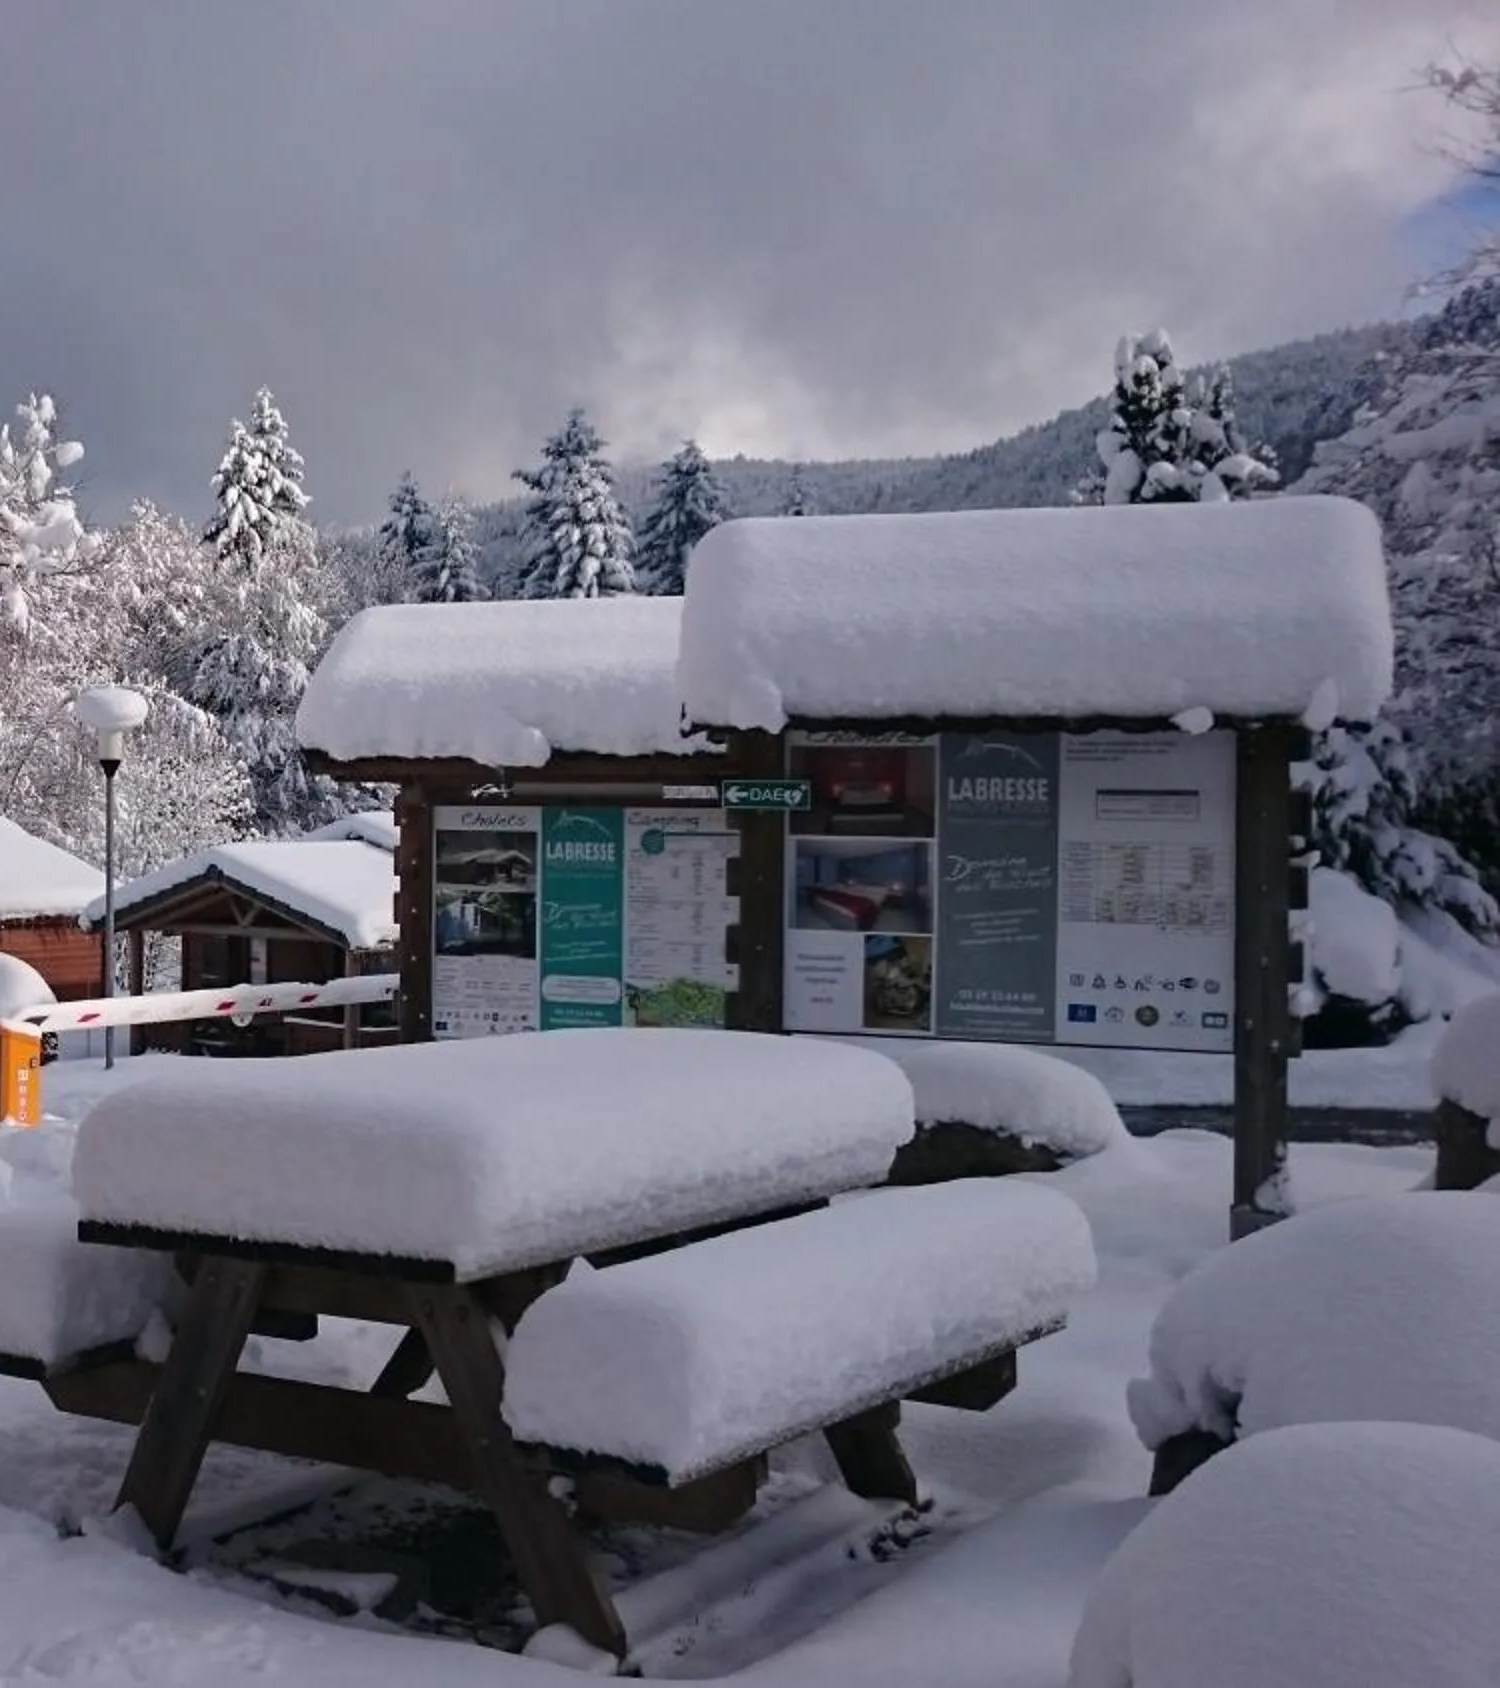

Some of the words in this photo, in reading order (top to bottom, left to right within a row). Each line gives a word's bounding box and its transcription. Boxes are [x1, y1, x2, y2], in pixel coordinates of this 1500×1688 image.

[750, 786, 785, 801] DAE
[947, 776, 1049, 801] LABRESSE
[546, 841, 616, 862] LABRESSE
